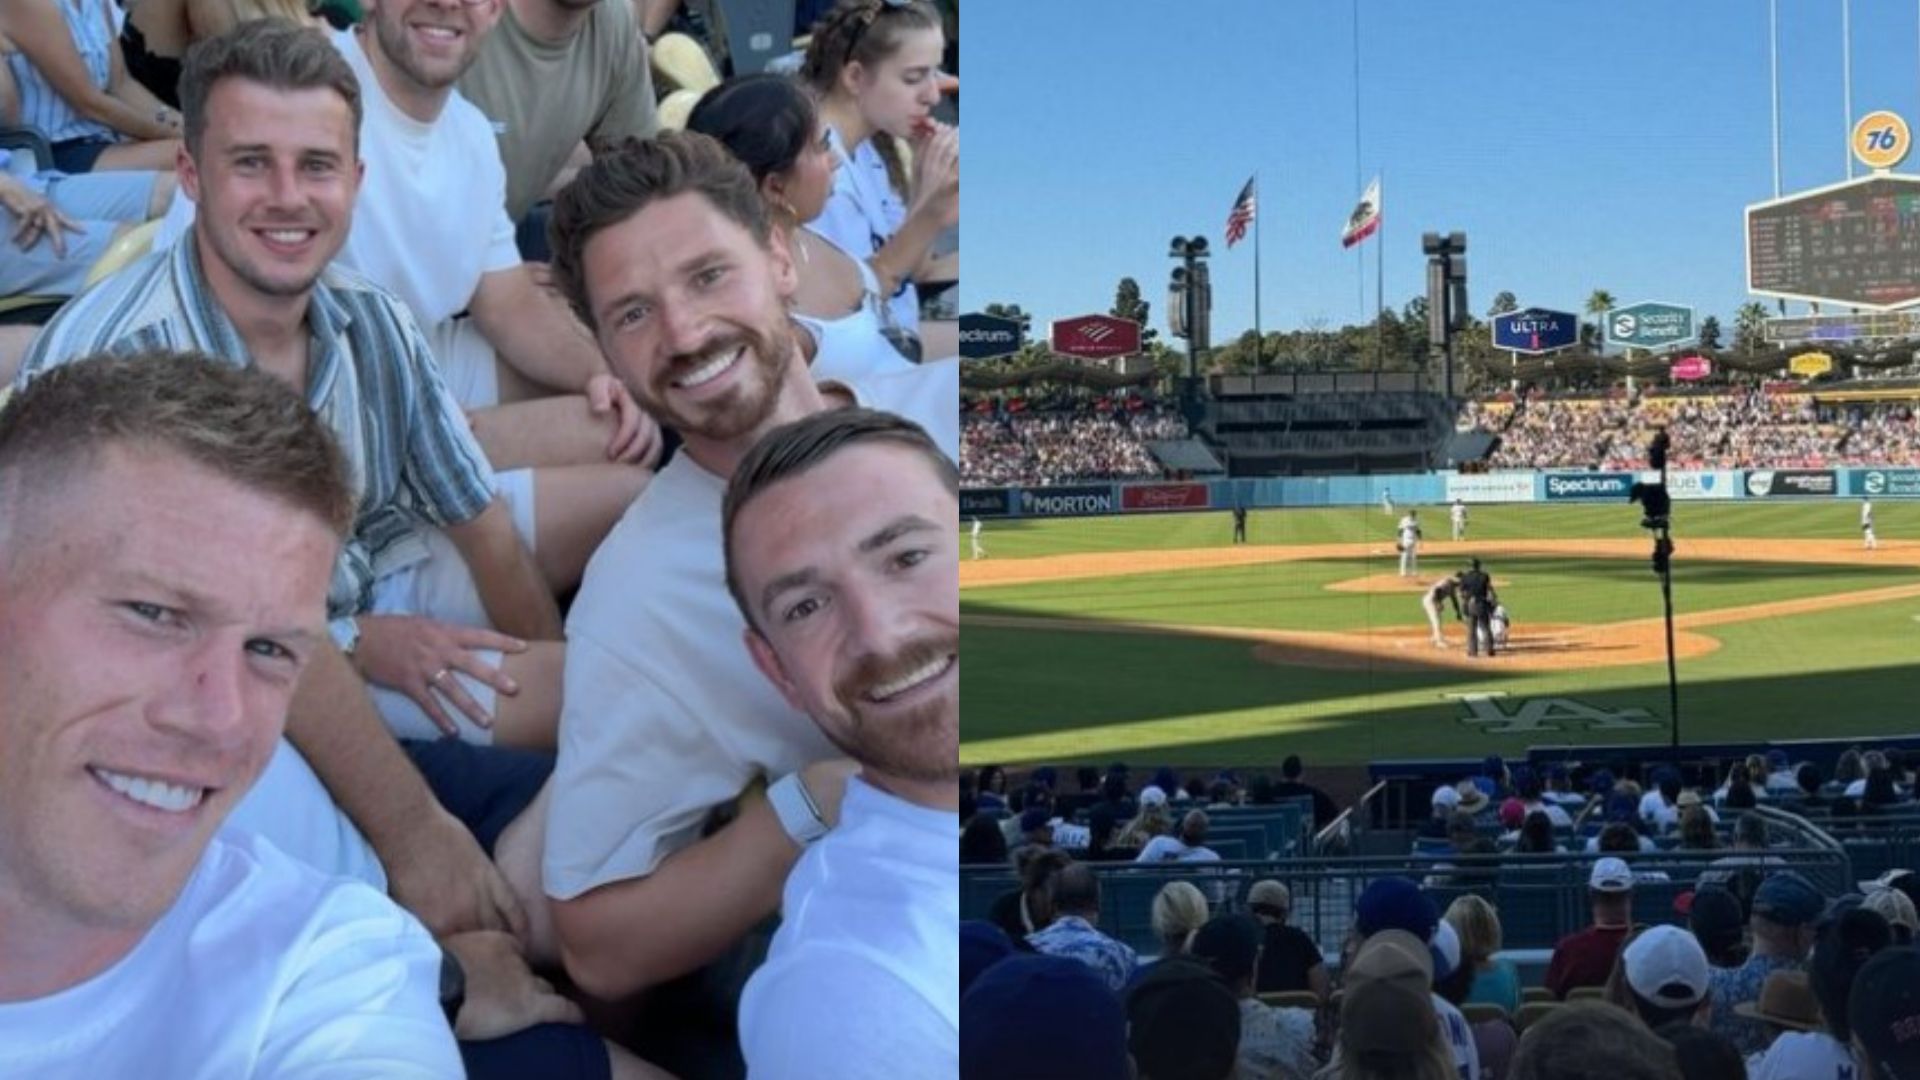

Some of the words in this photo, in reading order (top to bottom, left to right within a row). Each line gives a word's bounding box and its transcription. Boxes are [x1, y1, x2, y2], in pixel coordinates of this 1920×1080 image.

[1866, 126, 1897, 151] 76
[1509, 320, 1560, 334] ULTRA
[1550, 477, 1622, 494] Spectrum
[1034, 494, 1111, 513] MORTON
